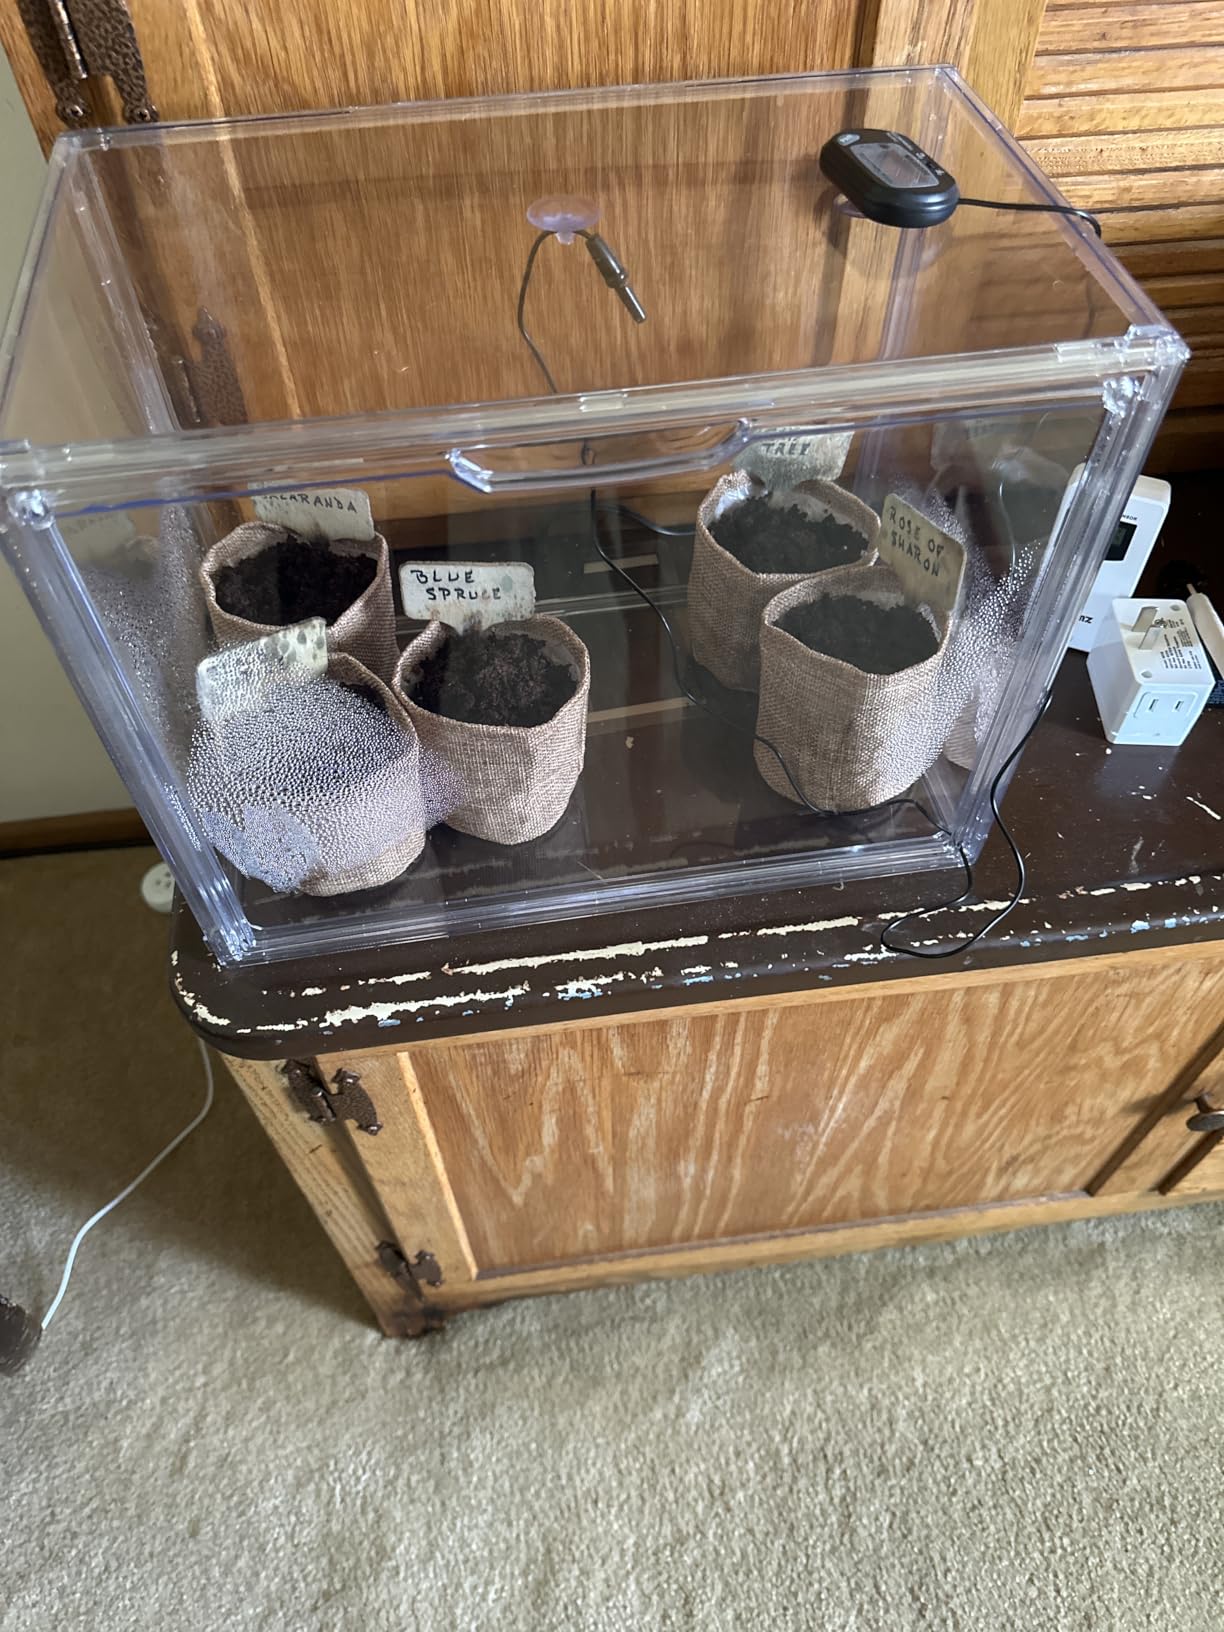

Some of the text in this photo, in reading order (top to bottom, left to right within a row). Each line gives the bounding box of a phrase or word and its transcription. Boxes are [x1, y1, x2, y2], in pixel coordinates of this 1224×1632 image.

[761, 442, 811, 456] TREE
[889, 505, 945, 558] ROSE OF
[891, 529, 940, 577] SHARON
[410, 569, 475, 584] BLUE
[426, 586, 502, 601] SPRUCE
